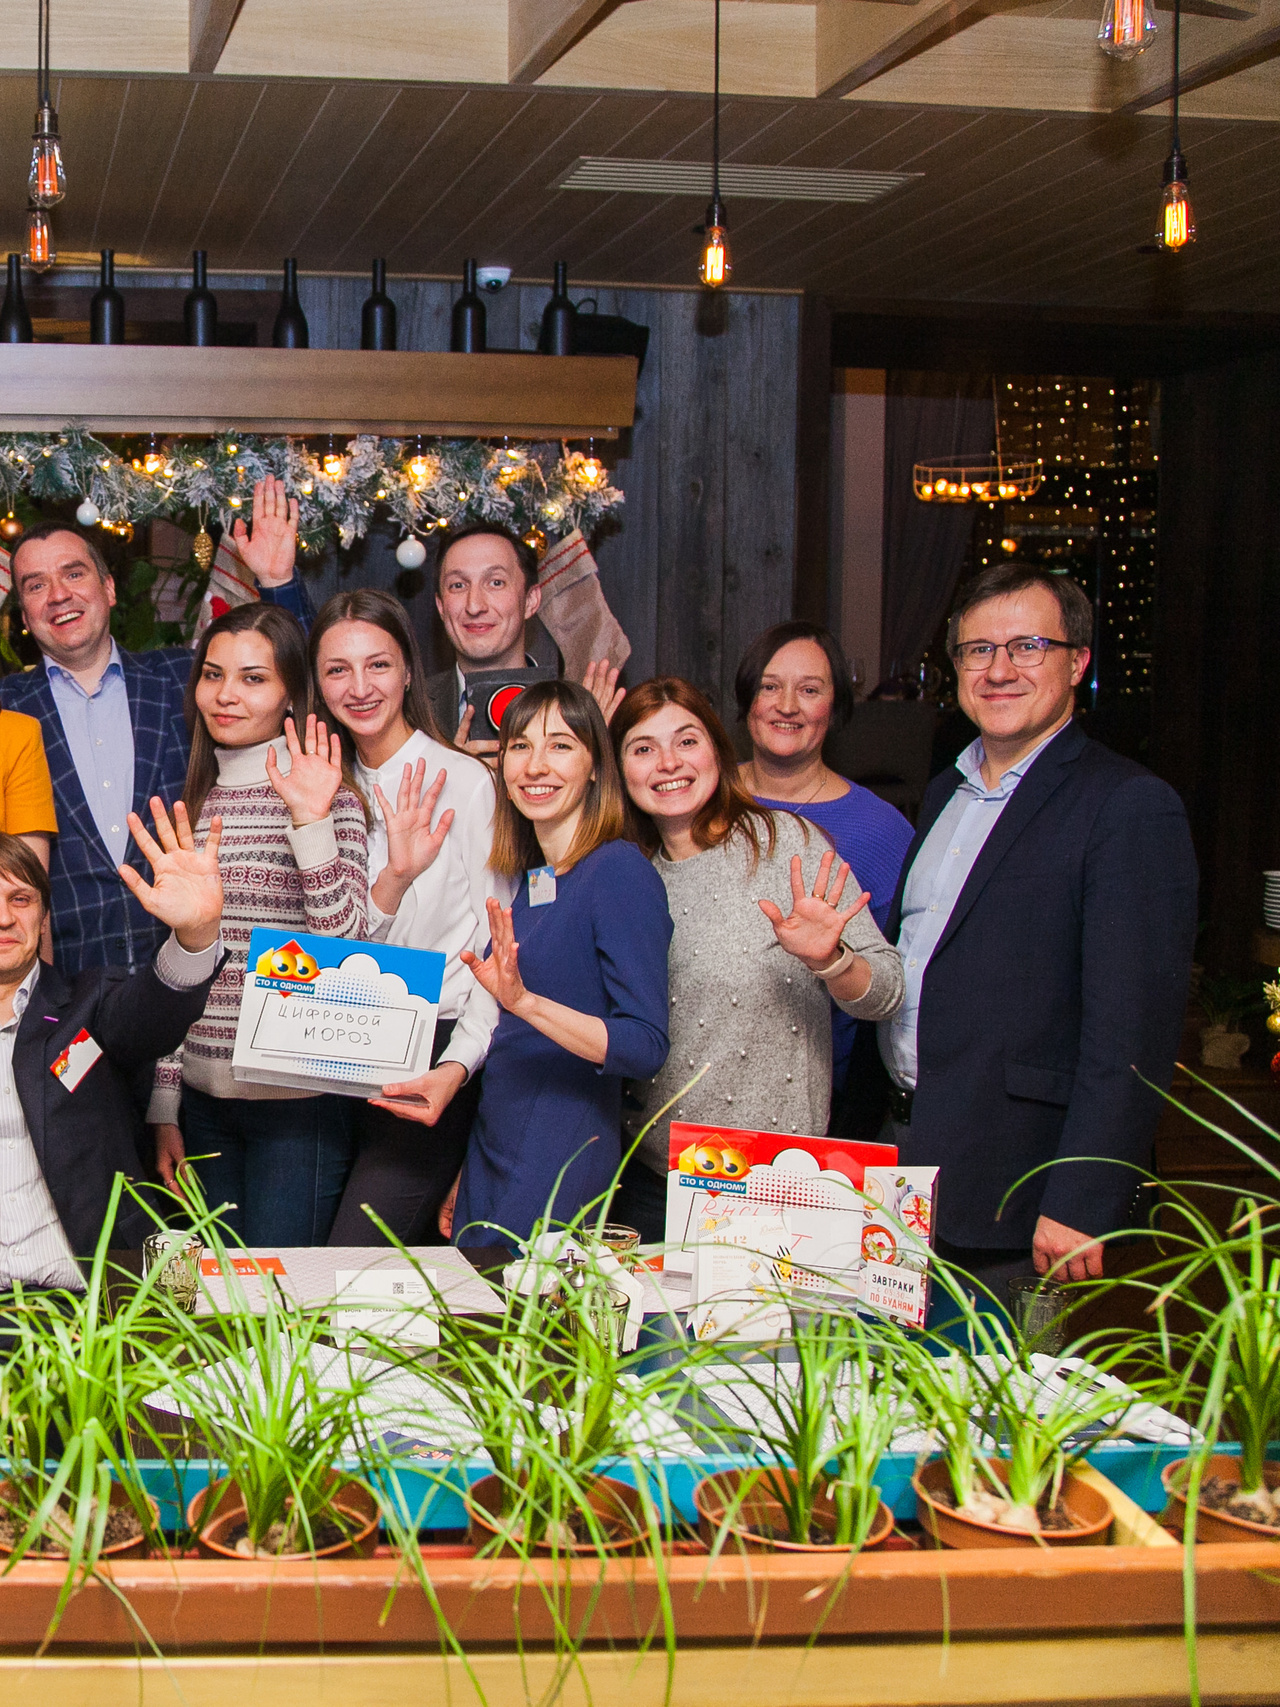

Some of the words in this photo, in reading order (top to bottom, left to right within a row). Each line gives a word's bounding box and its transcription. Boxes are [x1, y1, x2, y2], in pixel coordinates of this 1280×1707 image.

[255, 978, 271, 986] СТО
[280, 982, 315, 993] ОДНОМУ
[278, 1003, 381, 1026] ЦИФРОВОЙ
[304, 1026, 372, 1046] МОРОЗ
[679, 1176, 697, 1186] СТО
[698, 1179, 705, 1187] К
[706, 1180, 746, 1192] ОДНОМУ
[872, 1273, 914, 1294] ЗАВТРАКИ
[870, 1292, 880, 1303] ПО
[882, 1296, 914, 1313] БУДНЯМ
